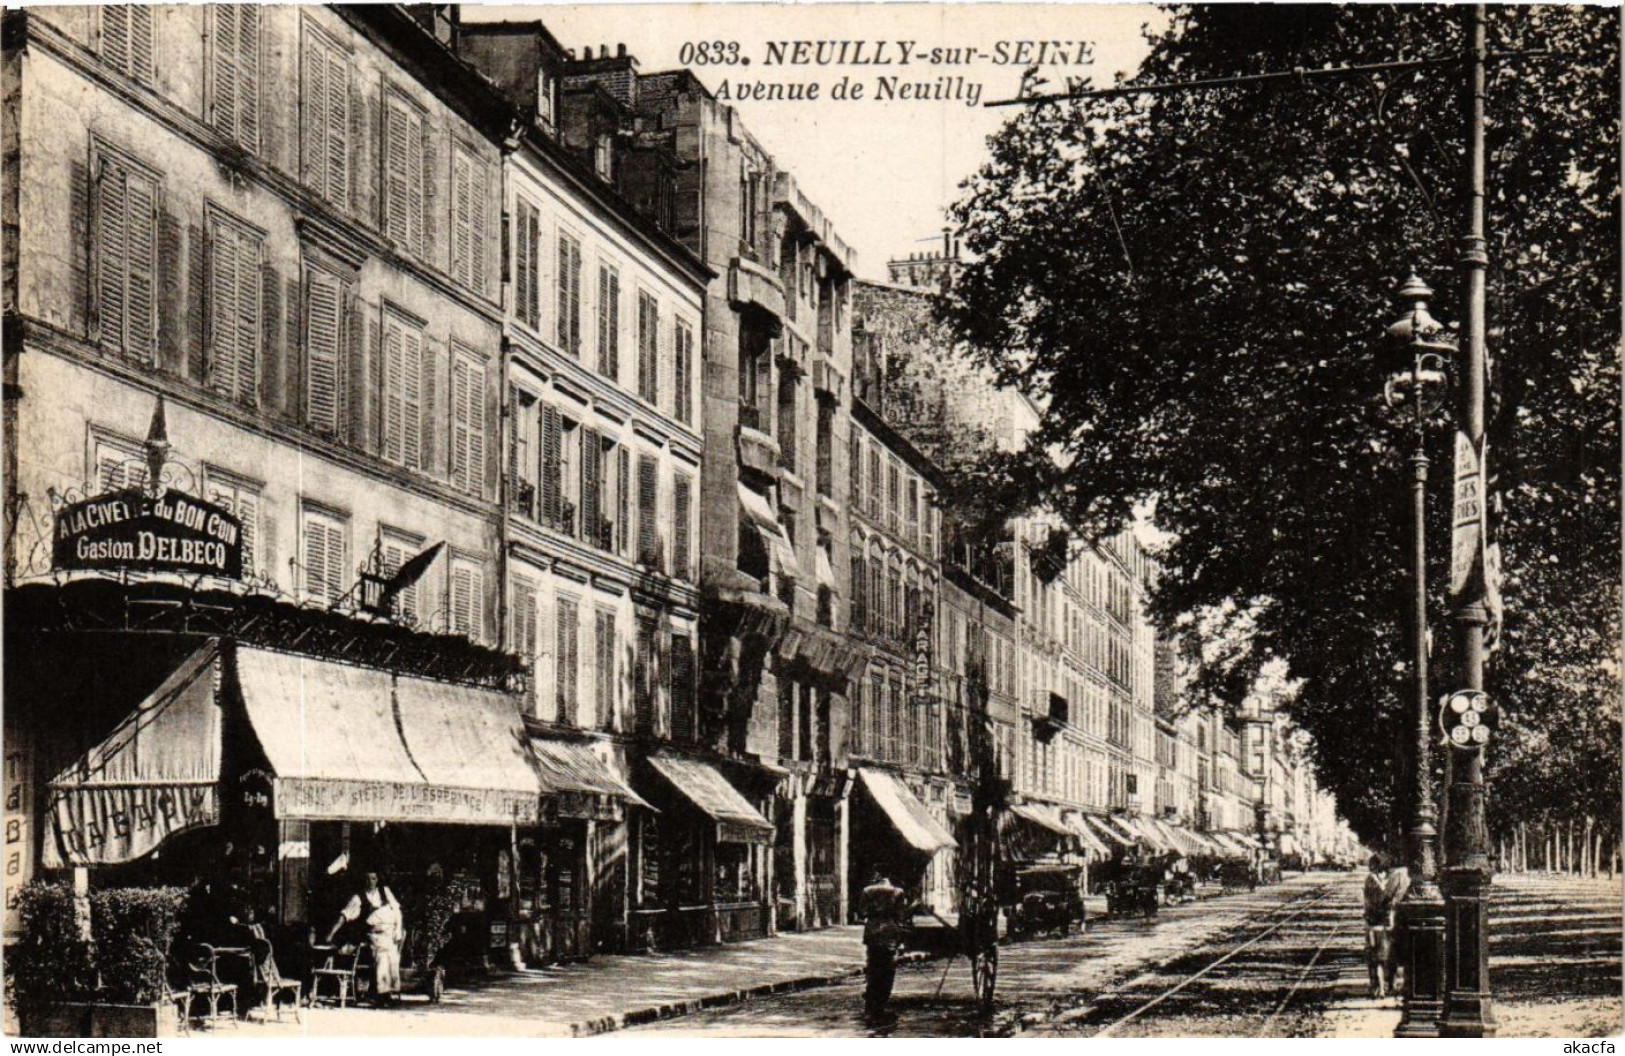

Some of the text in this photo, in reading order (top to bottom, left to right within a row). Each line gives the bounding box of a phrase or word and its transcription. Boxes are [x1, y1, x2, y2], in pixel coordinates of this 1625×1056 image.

[60, 519, 70, 539] A
[71, 511, 88, 533] LA
[154, 499, 173, 520] du
[174, 501, 206, 531] BON
[137, 531, 226, 569] DELBECQ
